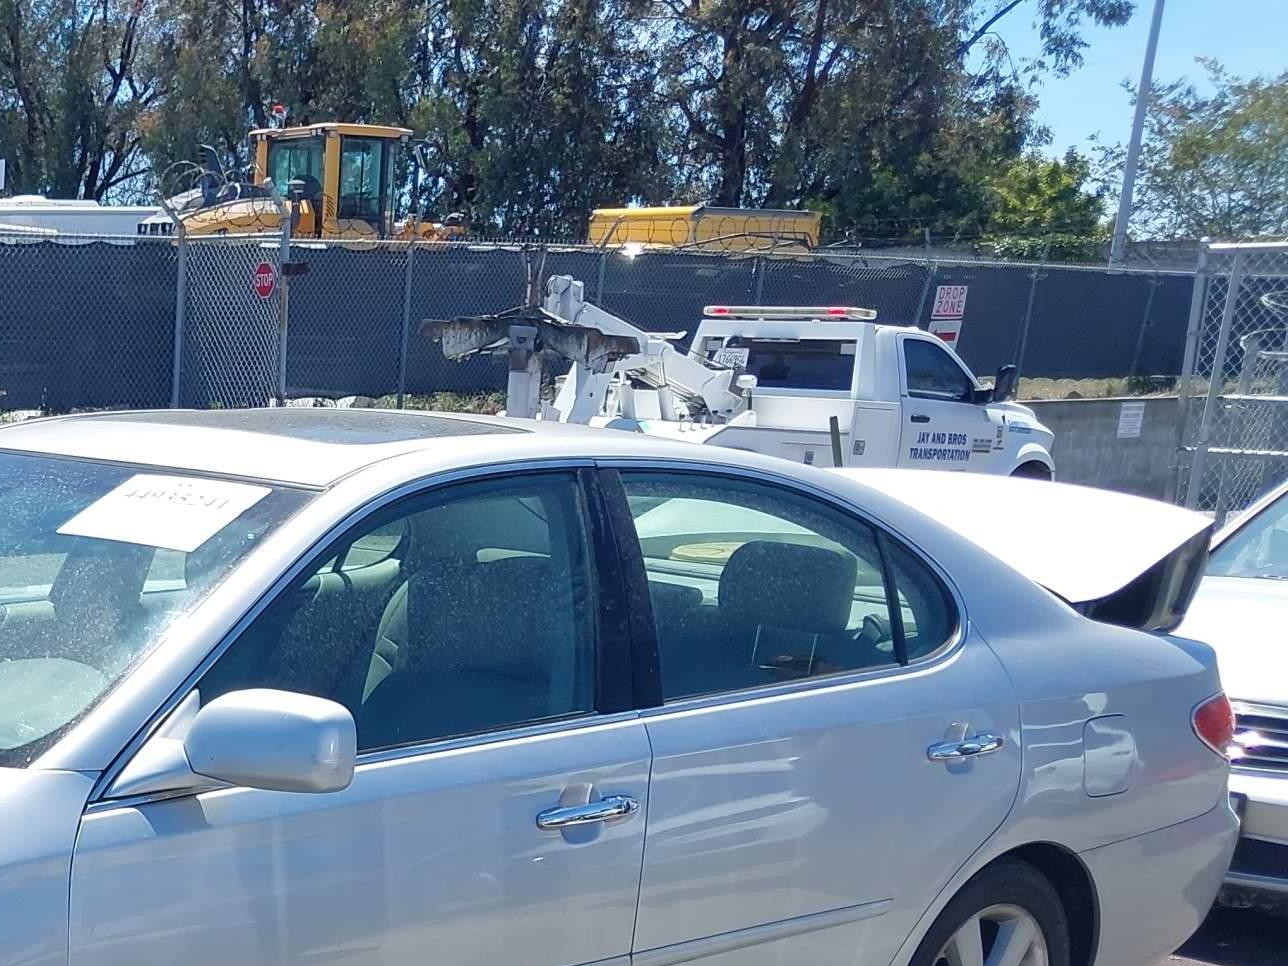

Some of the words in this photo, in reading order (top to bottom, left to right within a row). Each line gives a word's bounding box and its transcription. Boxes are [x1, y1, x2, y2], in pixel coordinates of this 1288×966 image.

[256, 272, 273, 288] STOP
[939, 287, 965, 300] DROP
[936, 300, 963, 314] ZONE
[917, 432, 930, 444] JAY
[931, 432, 947, 445] AND
[947, 433, 967, 446] BROS
[909, 447, 971, 462] TRANSPORTATION
